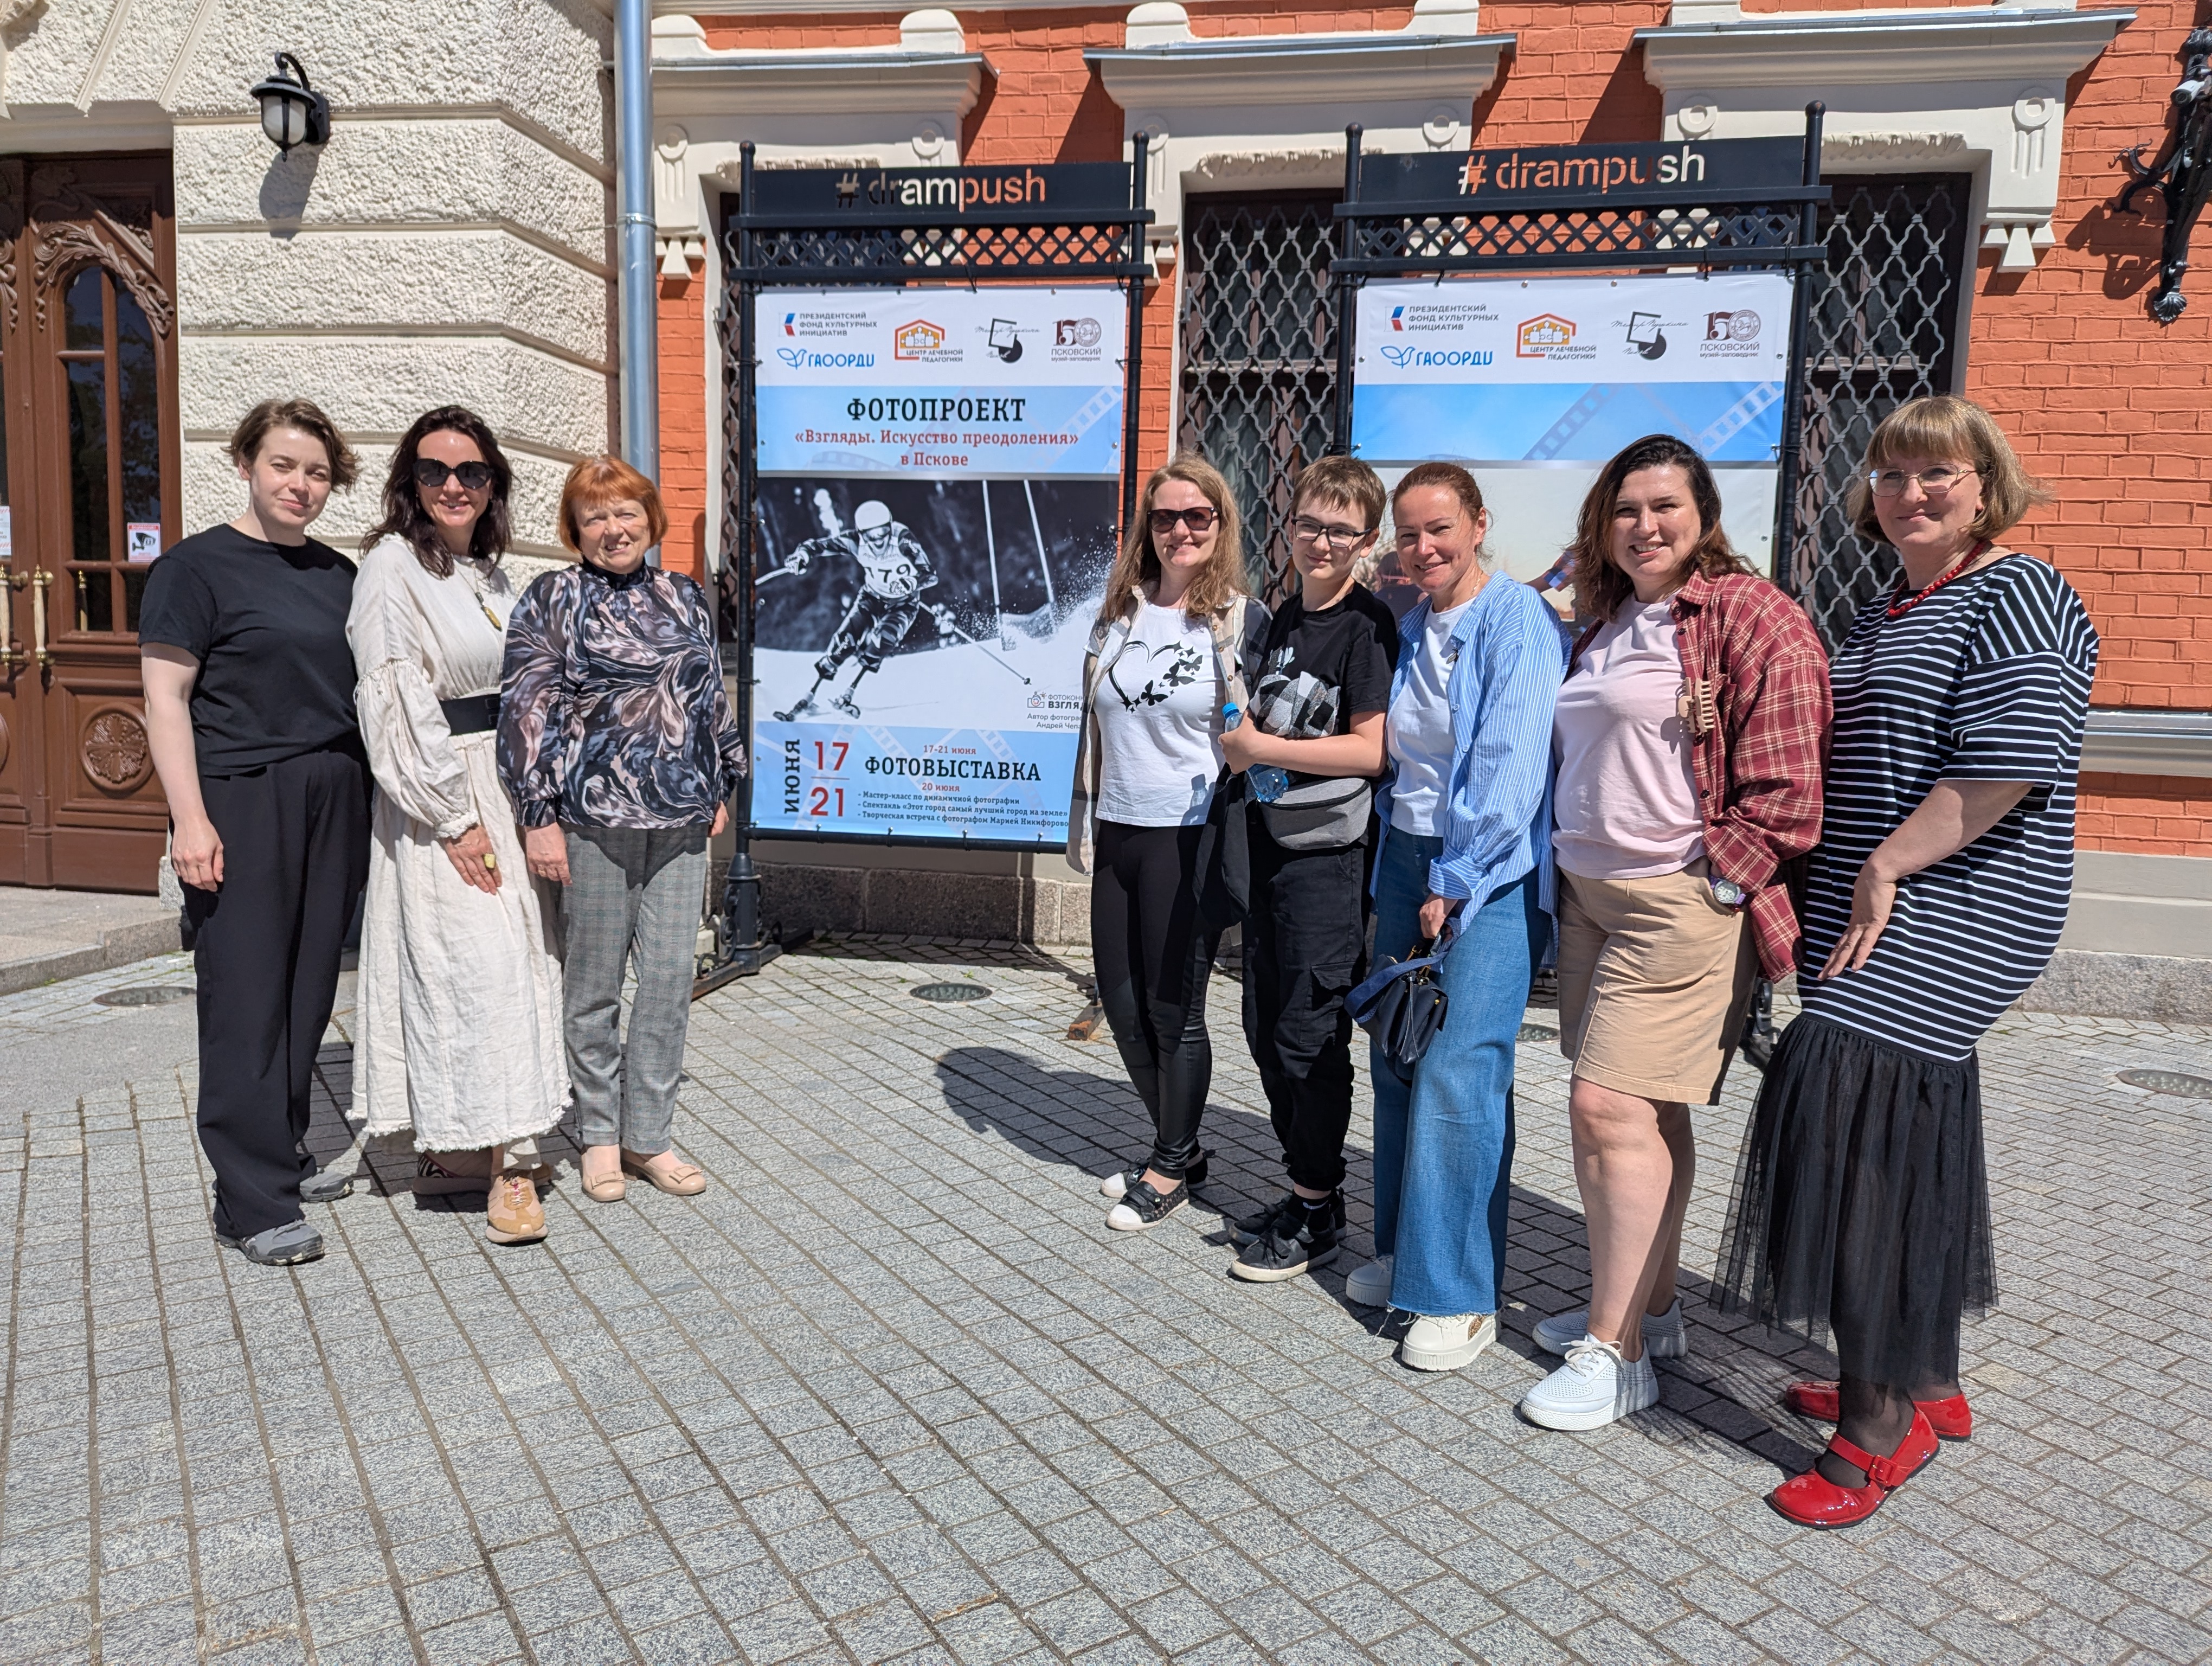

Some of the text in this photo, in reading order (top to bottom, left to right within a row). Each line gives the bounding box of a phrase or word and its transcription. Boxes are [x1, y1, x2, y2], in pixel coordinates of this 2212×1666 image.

[1409, 304, 1487, 313] ПРЕЗИДЕНТСКИЙ
[799, 312, 866, 320] ПРЕЗИДЕНТСКИЙ
[1409, 313, 1499, 323] ФОНД КУЛЬТУРНЫХ
[1051, 347, 1102, 356] ПСКОВСКИЙ
[1555, 344, 1597, 353] ЛЕЧЕБНОЙ
[1700, 342, 1760, 351] ПСКОВСКИЙ
[847, 398, 1026, 422] ФОТОПРОЕКТ
[795, 429, 1079, 447] «Взгляды. Искусство преодоления»
[901, 452, 969, 466] в Пскове
[814, 741, 849, 771] 17
[923, 745, 976, 755] 17-21 июня
[865, 756, 1041, 781] ФОТОВЫСТАВКА
[784, 739, 801, 814] ИЮНЯ
[922, 783, 933, 791] 20
[810, 786, 844, 817] 21
[863, 791, 911, 800] Мастер-класс
[973, 796, 1020, 805] фотографии
[862, 801, 901, 809] Спектакль
[862, 811, 904, 820] Творческая
[906, 813, 935, 822] встреча
[942, 815, 988, 824] фотографом
[990, 817, 1019, 825] Марией
[1020, 818, 1069, 827] Никифорово
